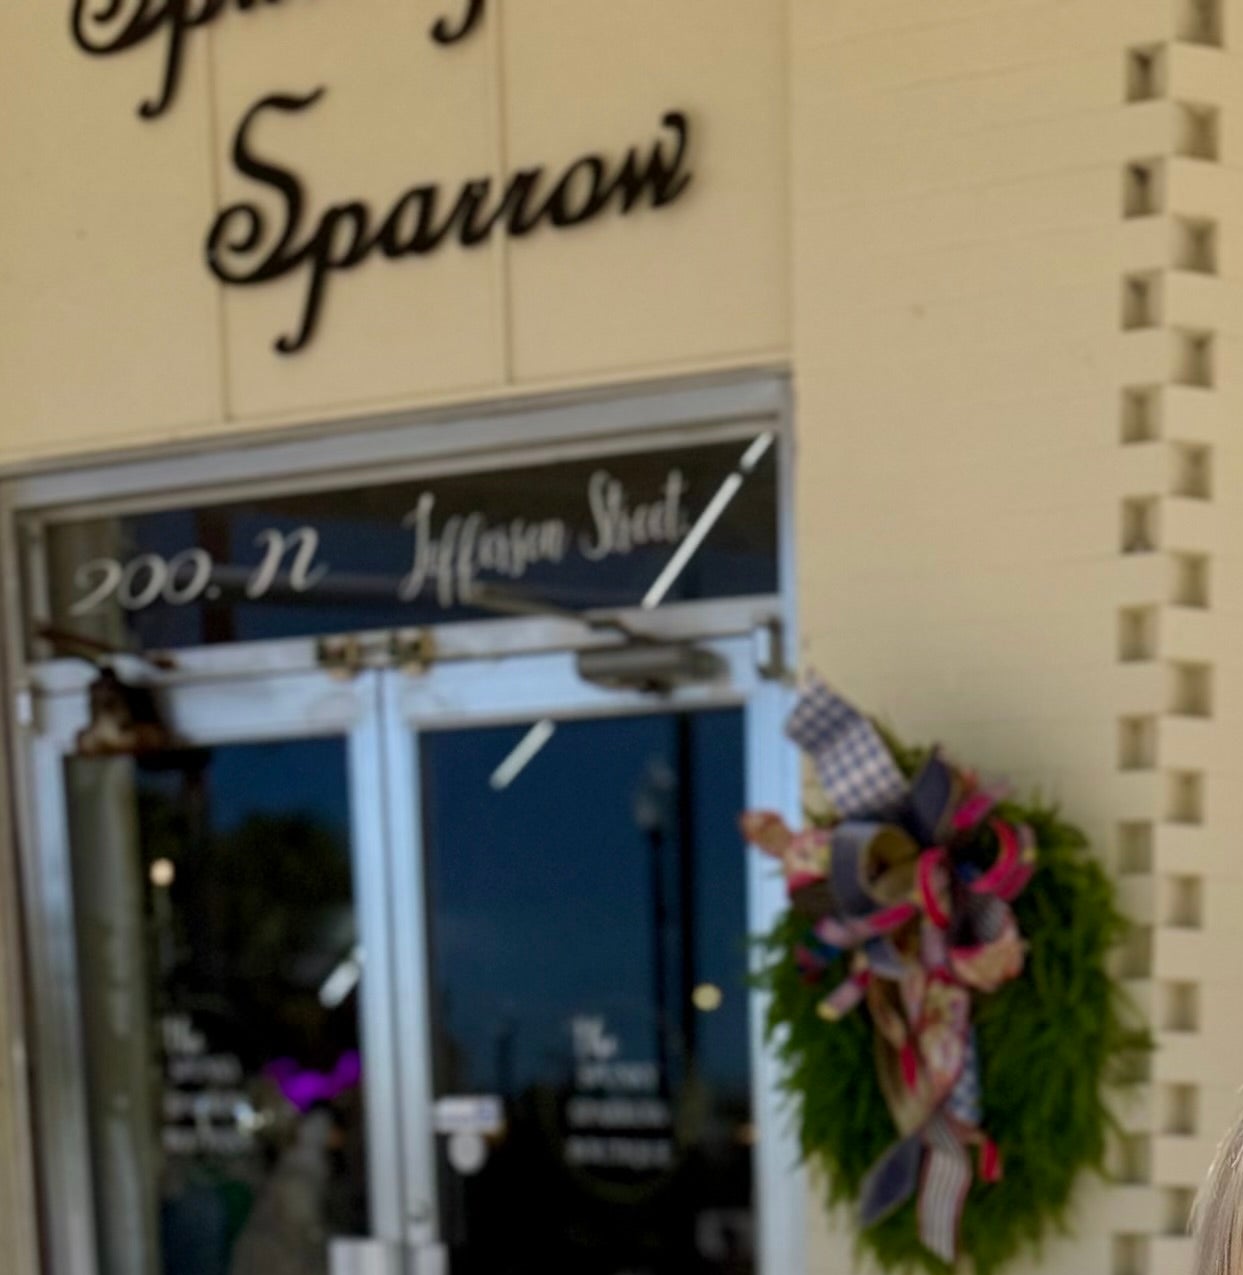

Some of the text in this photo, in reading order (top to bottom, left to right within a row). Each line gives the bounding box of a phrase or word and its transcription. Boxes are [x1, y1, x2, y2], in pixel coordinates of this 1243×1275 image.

[206, 85, 692, 355] Sparrow
[401, 490, 568, 610] Jefferson
[579, 468, 689, 559] Street
